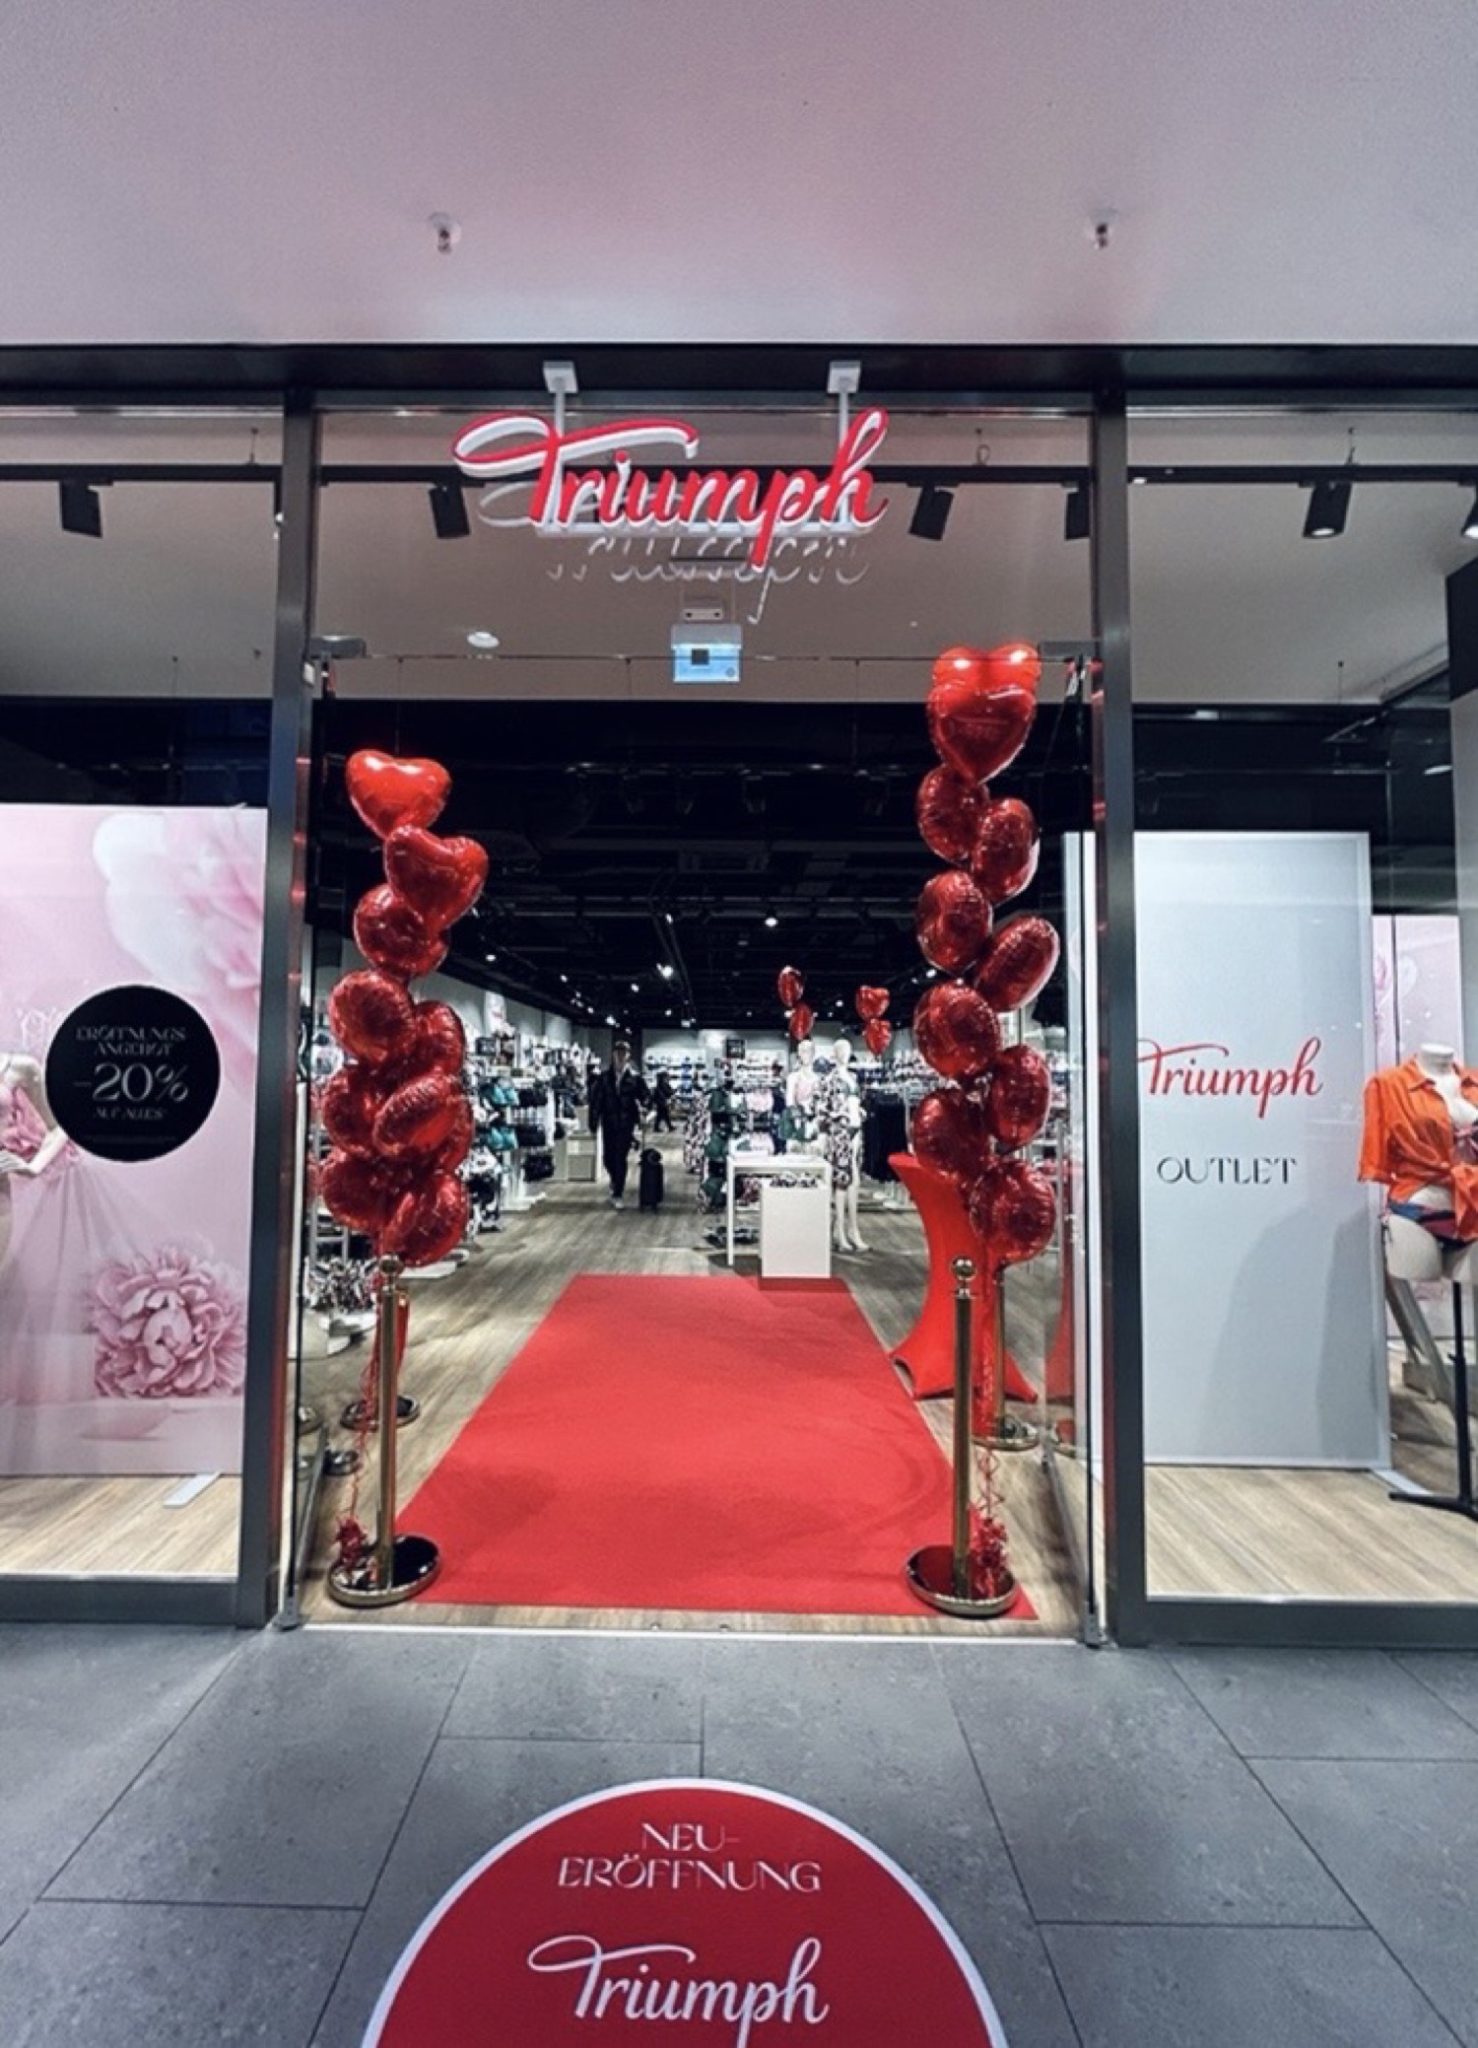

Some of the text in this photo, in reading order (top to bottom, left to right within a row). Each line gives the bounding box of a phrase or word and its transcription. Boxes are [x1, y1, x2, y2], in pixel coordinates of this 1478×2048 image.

[452, 406, 888, 573] Triumph
[73, 1062, 189, 1103] -20%
[1138, 1037, 1323, 1119] Triumph
[1157, 1156, 1297, 1184] OUTLET
[641, 1822, 741, 1851] NEU-
[558, 1853, 821, 1892] ERÖFFNUNG
[528, 1936, 830, 2048] Triumph
